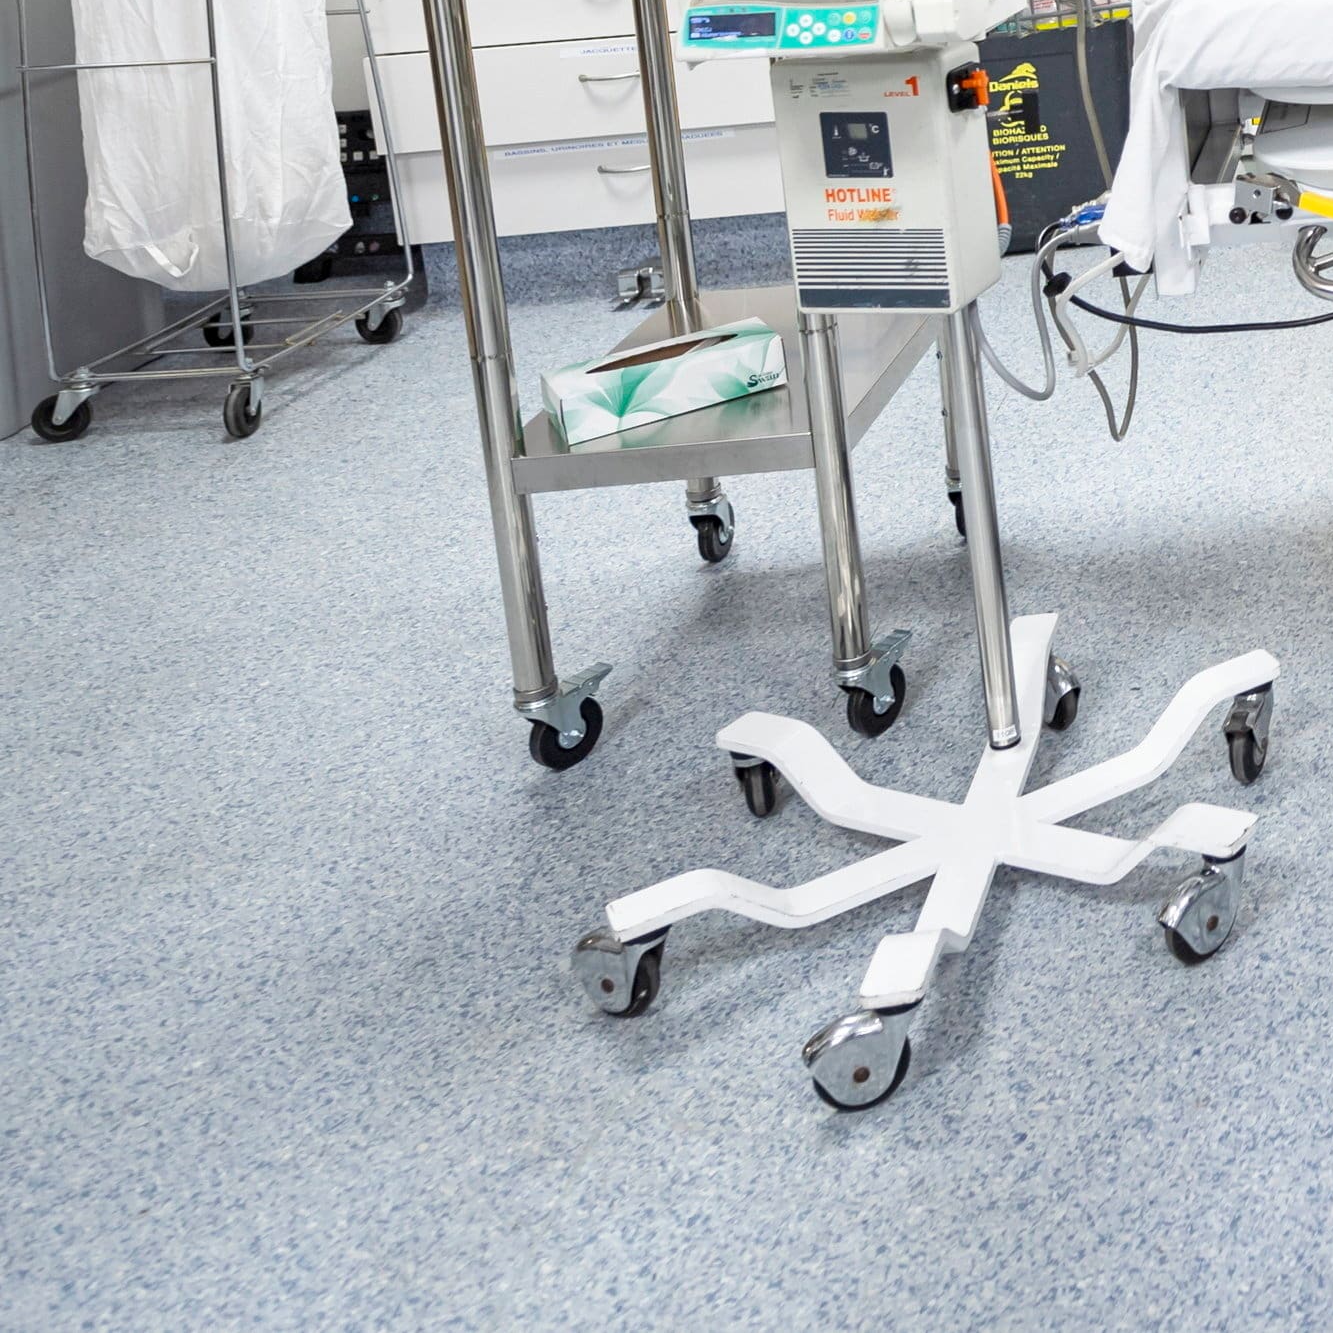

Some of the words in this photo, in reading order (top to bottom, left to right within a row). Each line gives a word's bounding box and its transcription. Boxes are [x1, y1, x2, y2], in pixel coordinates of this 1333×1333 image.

[905, 75, 920, 97] 1
[988, 78, 1039, 92] Daniels
[992, 124, 1047, 136] BIOHAD
[992, 132, 1050, 146] BIORISQUES
[551, 141, 604, 152] URINOIRES
[992, 149, 1014, 158] TION
[1021, 144, 1066, 156] ATTENTION
[995, 157, 1020, 166] ximum
[1021, 153, 1055, 164] Capacity
[1022, 160, 1058, 171] Maximale
[1014, 171, 1034, 180] 22kg
[825, 187, 893, 203] HOTLINE
[828, 208, 855, 222] Fluid
